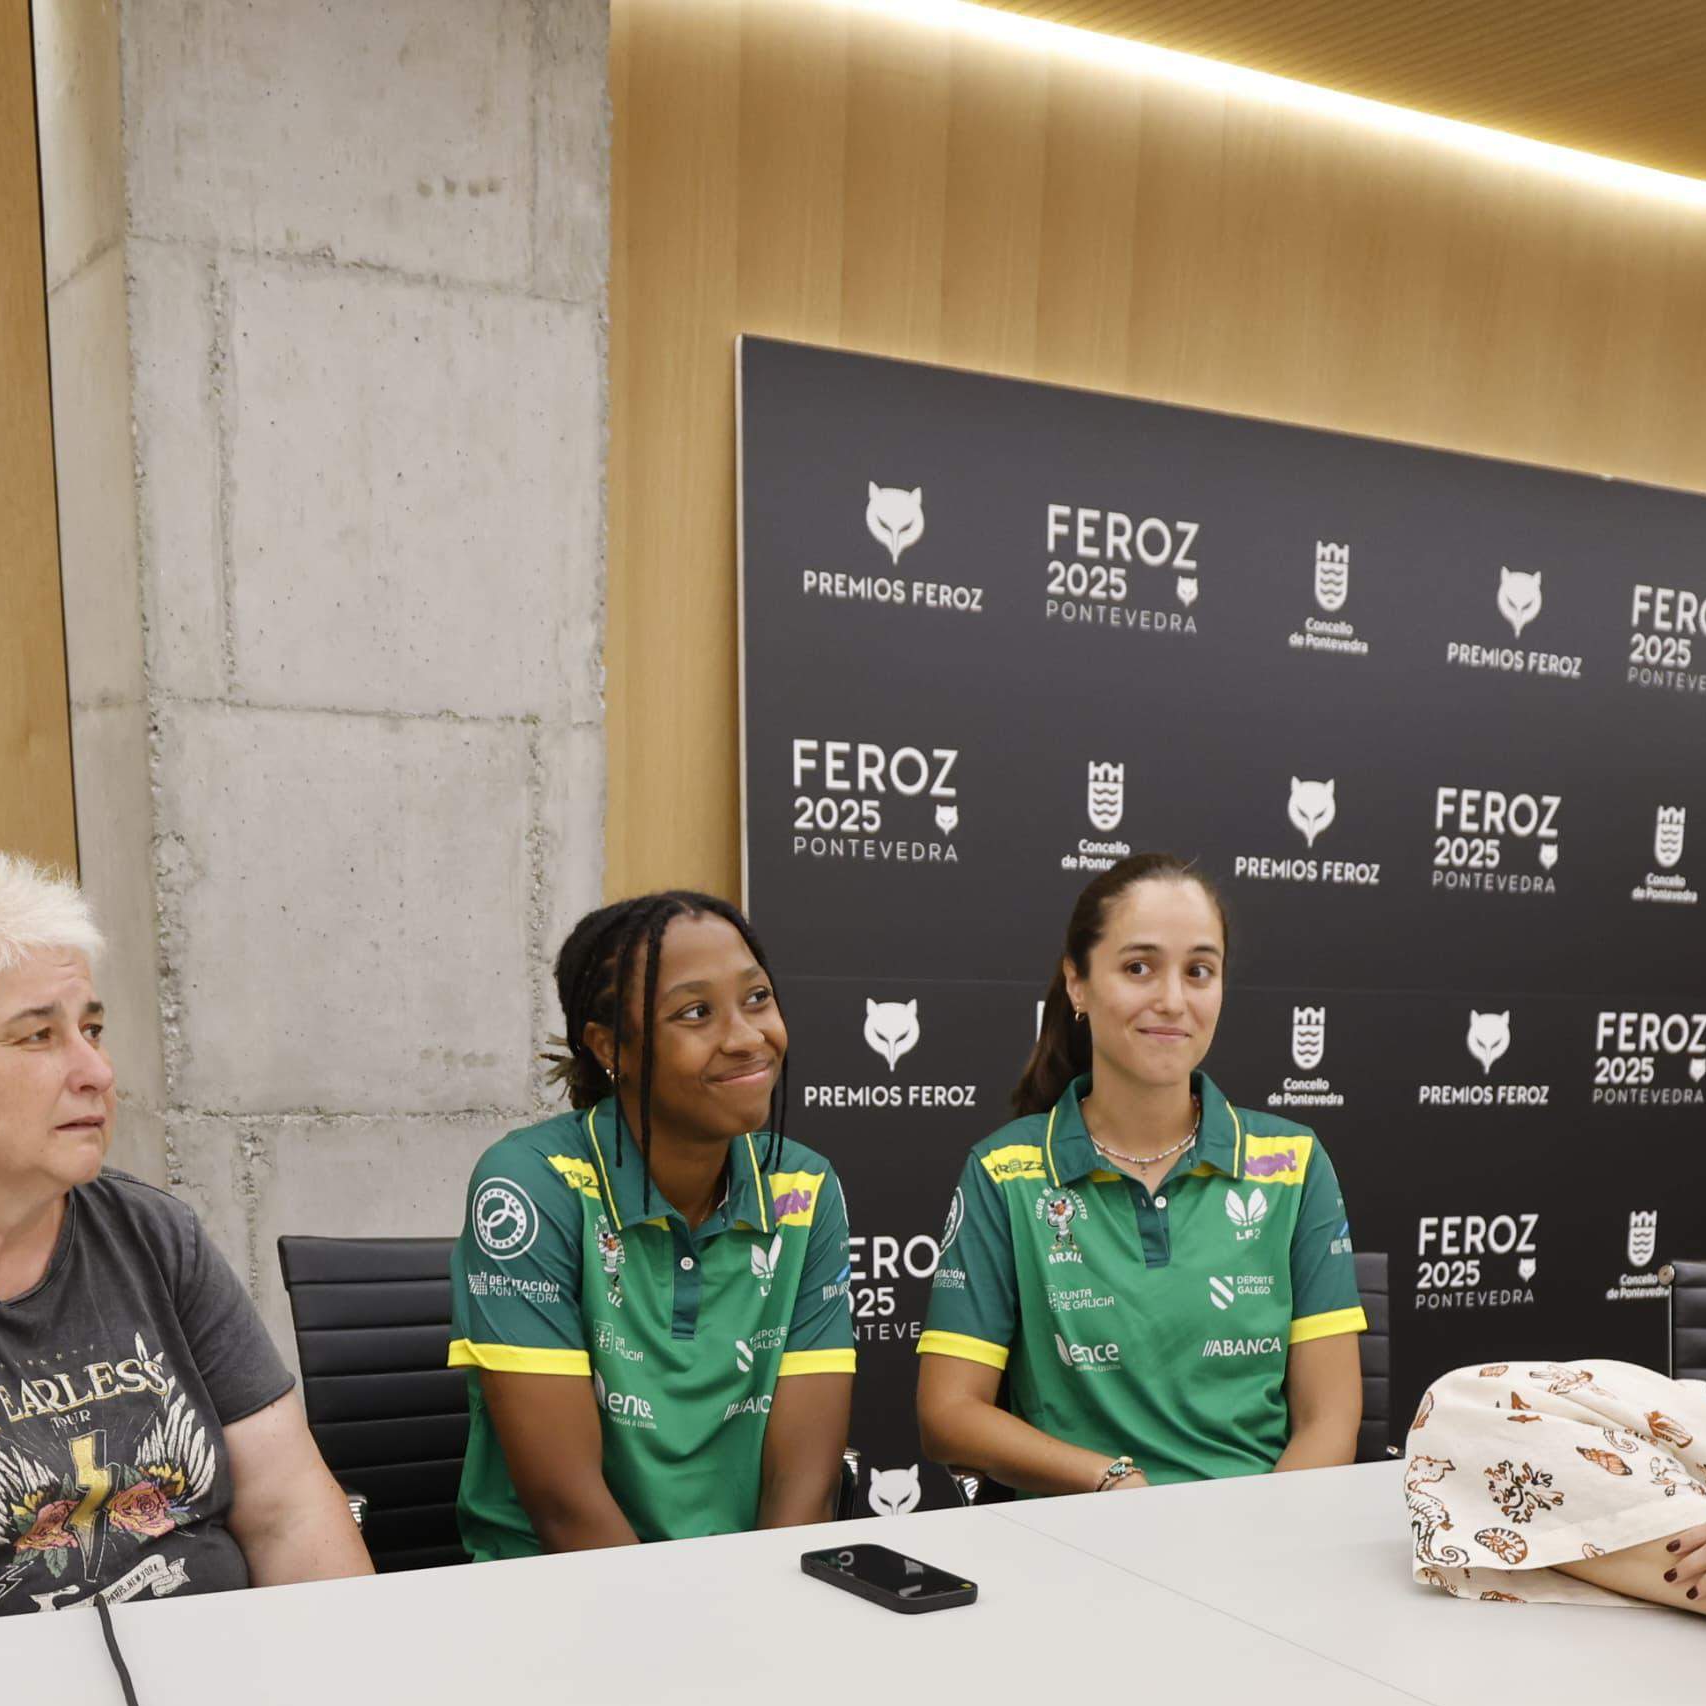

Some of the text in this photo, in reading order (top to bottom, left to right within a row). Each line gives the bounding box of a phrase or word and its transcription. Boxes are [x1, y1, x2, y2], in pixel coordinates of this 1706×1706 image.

[1047, 503, 1200, 570] FEROZ
[804, 569, 983, 612] PREMIOS FEROZ
[1047, 561, 1128, 600] 2025
[1046, 600, 1197, 633] PONTEVEDRA
[1305, 616, 1354, 636] Concello
[1288, 631, 1370, 654] de Pontevedra
[1630, 633, 1692, 667] 2025
[1447, 642, 1582, 678] PREMIOS FEROZ
[794, 738, 958, 797] FEROZ
[794, 796, 882, 832] 2025
[1436, 786, 1562, 838] FEROZ
[794, 836, 958, 862] PONTEVEDRA
[1078, 838, 1131, 857] Concello
[1434, 836, 1500, 868] 2025
[1061, 854, 1117, 871] de Ponte
[1234, 856, 1380, 885] PREMIOS FEROZ
[1432, 870, 1556, 893] PONTEVEDRA
[1646, 873, 1686, 889] Concello
[1595, 1056, 1655, 1085] 2025
[805, 1085, 976, 1107] PREMIOS FEROZ
[1283, 1077, 1329, 1092] Concello
[1419, 1085, 1550, 1105] PREMIOS FEROZ
[1592, 1087, 1704, 1105] PONTEVEDRA
[1267, 1092, 1344, 1106] de Pontevedra
[1418, 1213, 1538, 1257] FEROZ
[849, 1234, 939, 1281] ERO
[1237, 1275, 1275, 1285] DEPORTE
[1417, 1259, 1481, 1289] 2025
[1619, 1273, 1659, 1286] Concello
[1059, 1287, 1092, 1300] XUNTA
[1237, 1286, 1271, 1295] GALEGO
[1415, 1289, 1534, 1309] PONTEVEDRA
[1073, 1295, 1115, 1310] GALICIA
[1069, 1343, 1120, 1364] ence
[607, 1392, 654, 1420] ence
[49, 1410, 91, 1429] TOUR
